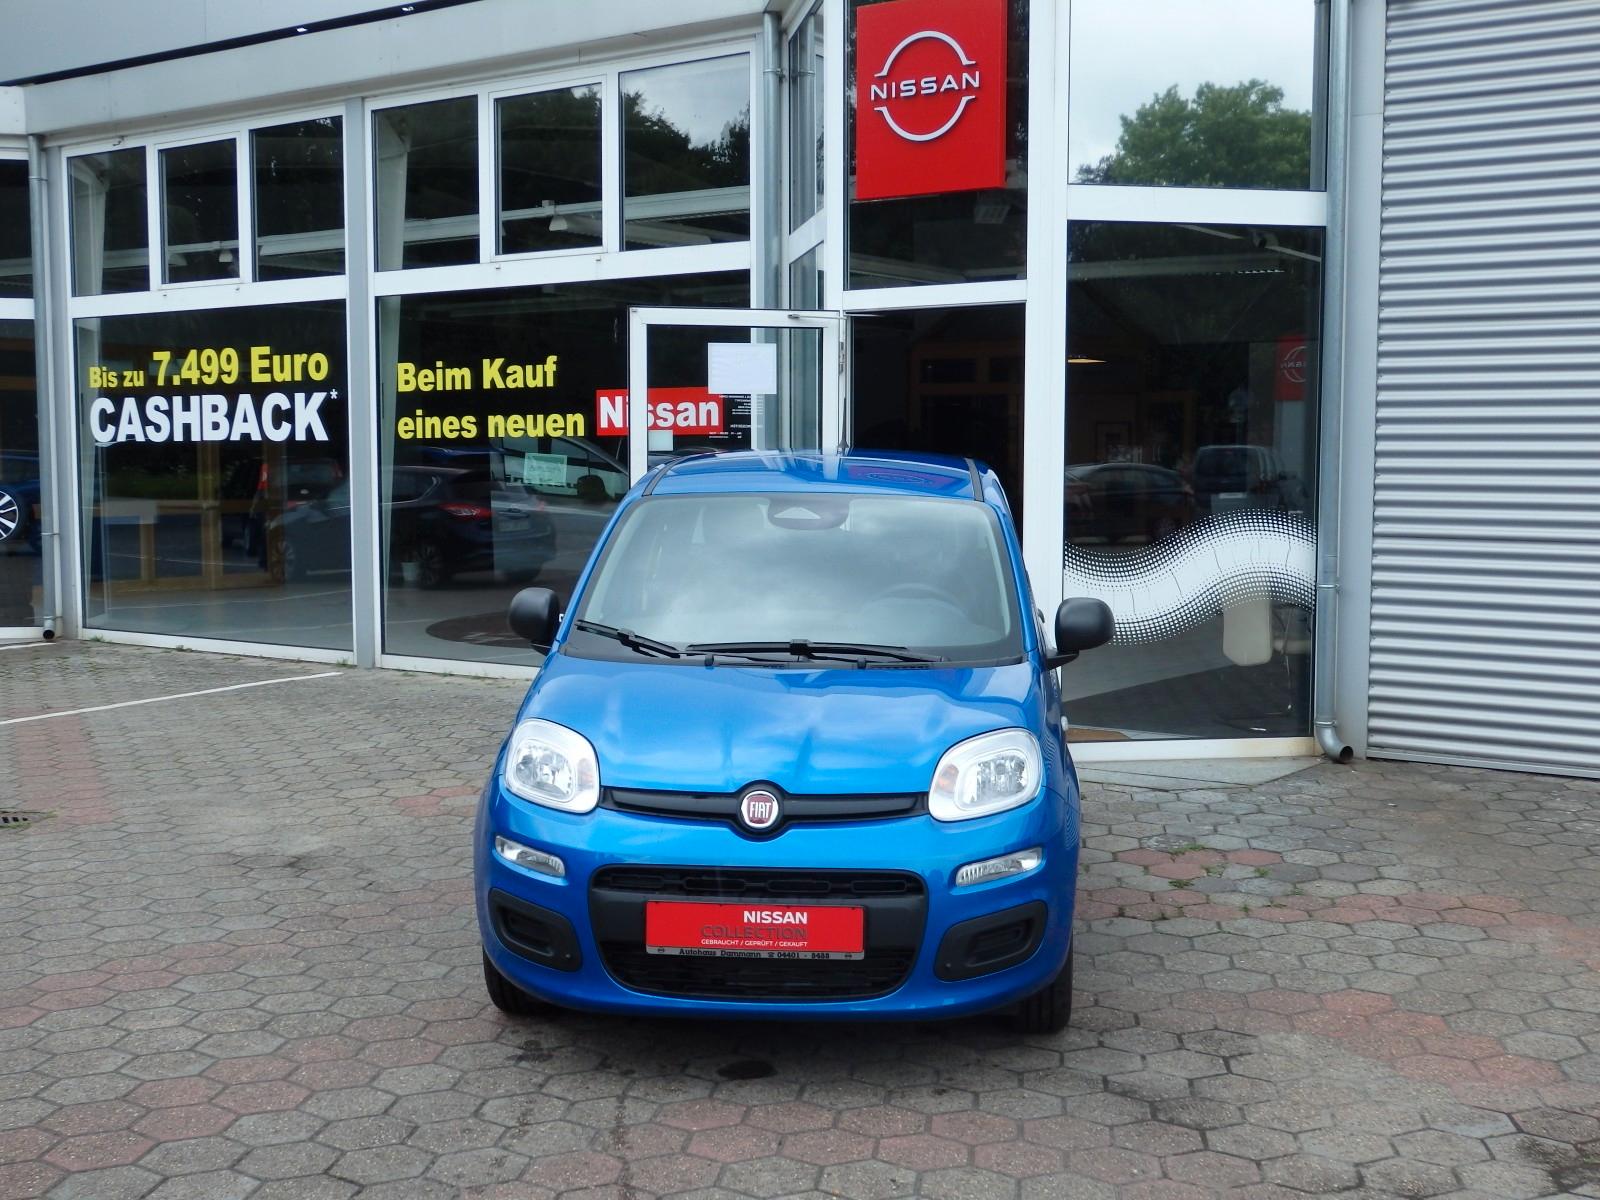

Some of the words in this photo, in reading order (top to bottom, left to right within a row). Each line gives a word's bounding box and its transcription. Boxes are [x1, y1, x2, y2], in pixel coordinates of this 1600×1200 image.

[870, 71, 980, 100] NISSAN
[88, 366, 117, 388] Bis
[123, 370, 145, 388] zu
[152, 347, 239, 386] 7.499
[250, 346, 329, 383] Euro
[397, 360, 472, 393] Beim
[482, 355, 557, 389] Kauf
[397, 409, 478, 440] eines
[487, 411, 585, 438] neuen
[599, 395, 719, 429] Nsan
[749, 801, 772, 819] FIAT
[743, 911, 808, 924] NISSAN
[701, 925, 808, 940] COLLECTION
[701, 938, 739, 946] GEBRAUCHT
[744, 939, 774, 947] GEPRÜFT
[679, 948, 717, 957] Autohaus
[720, 949, 762, 958] Dammann
